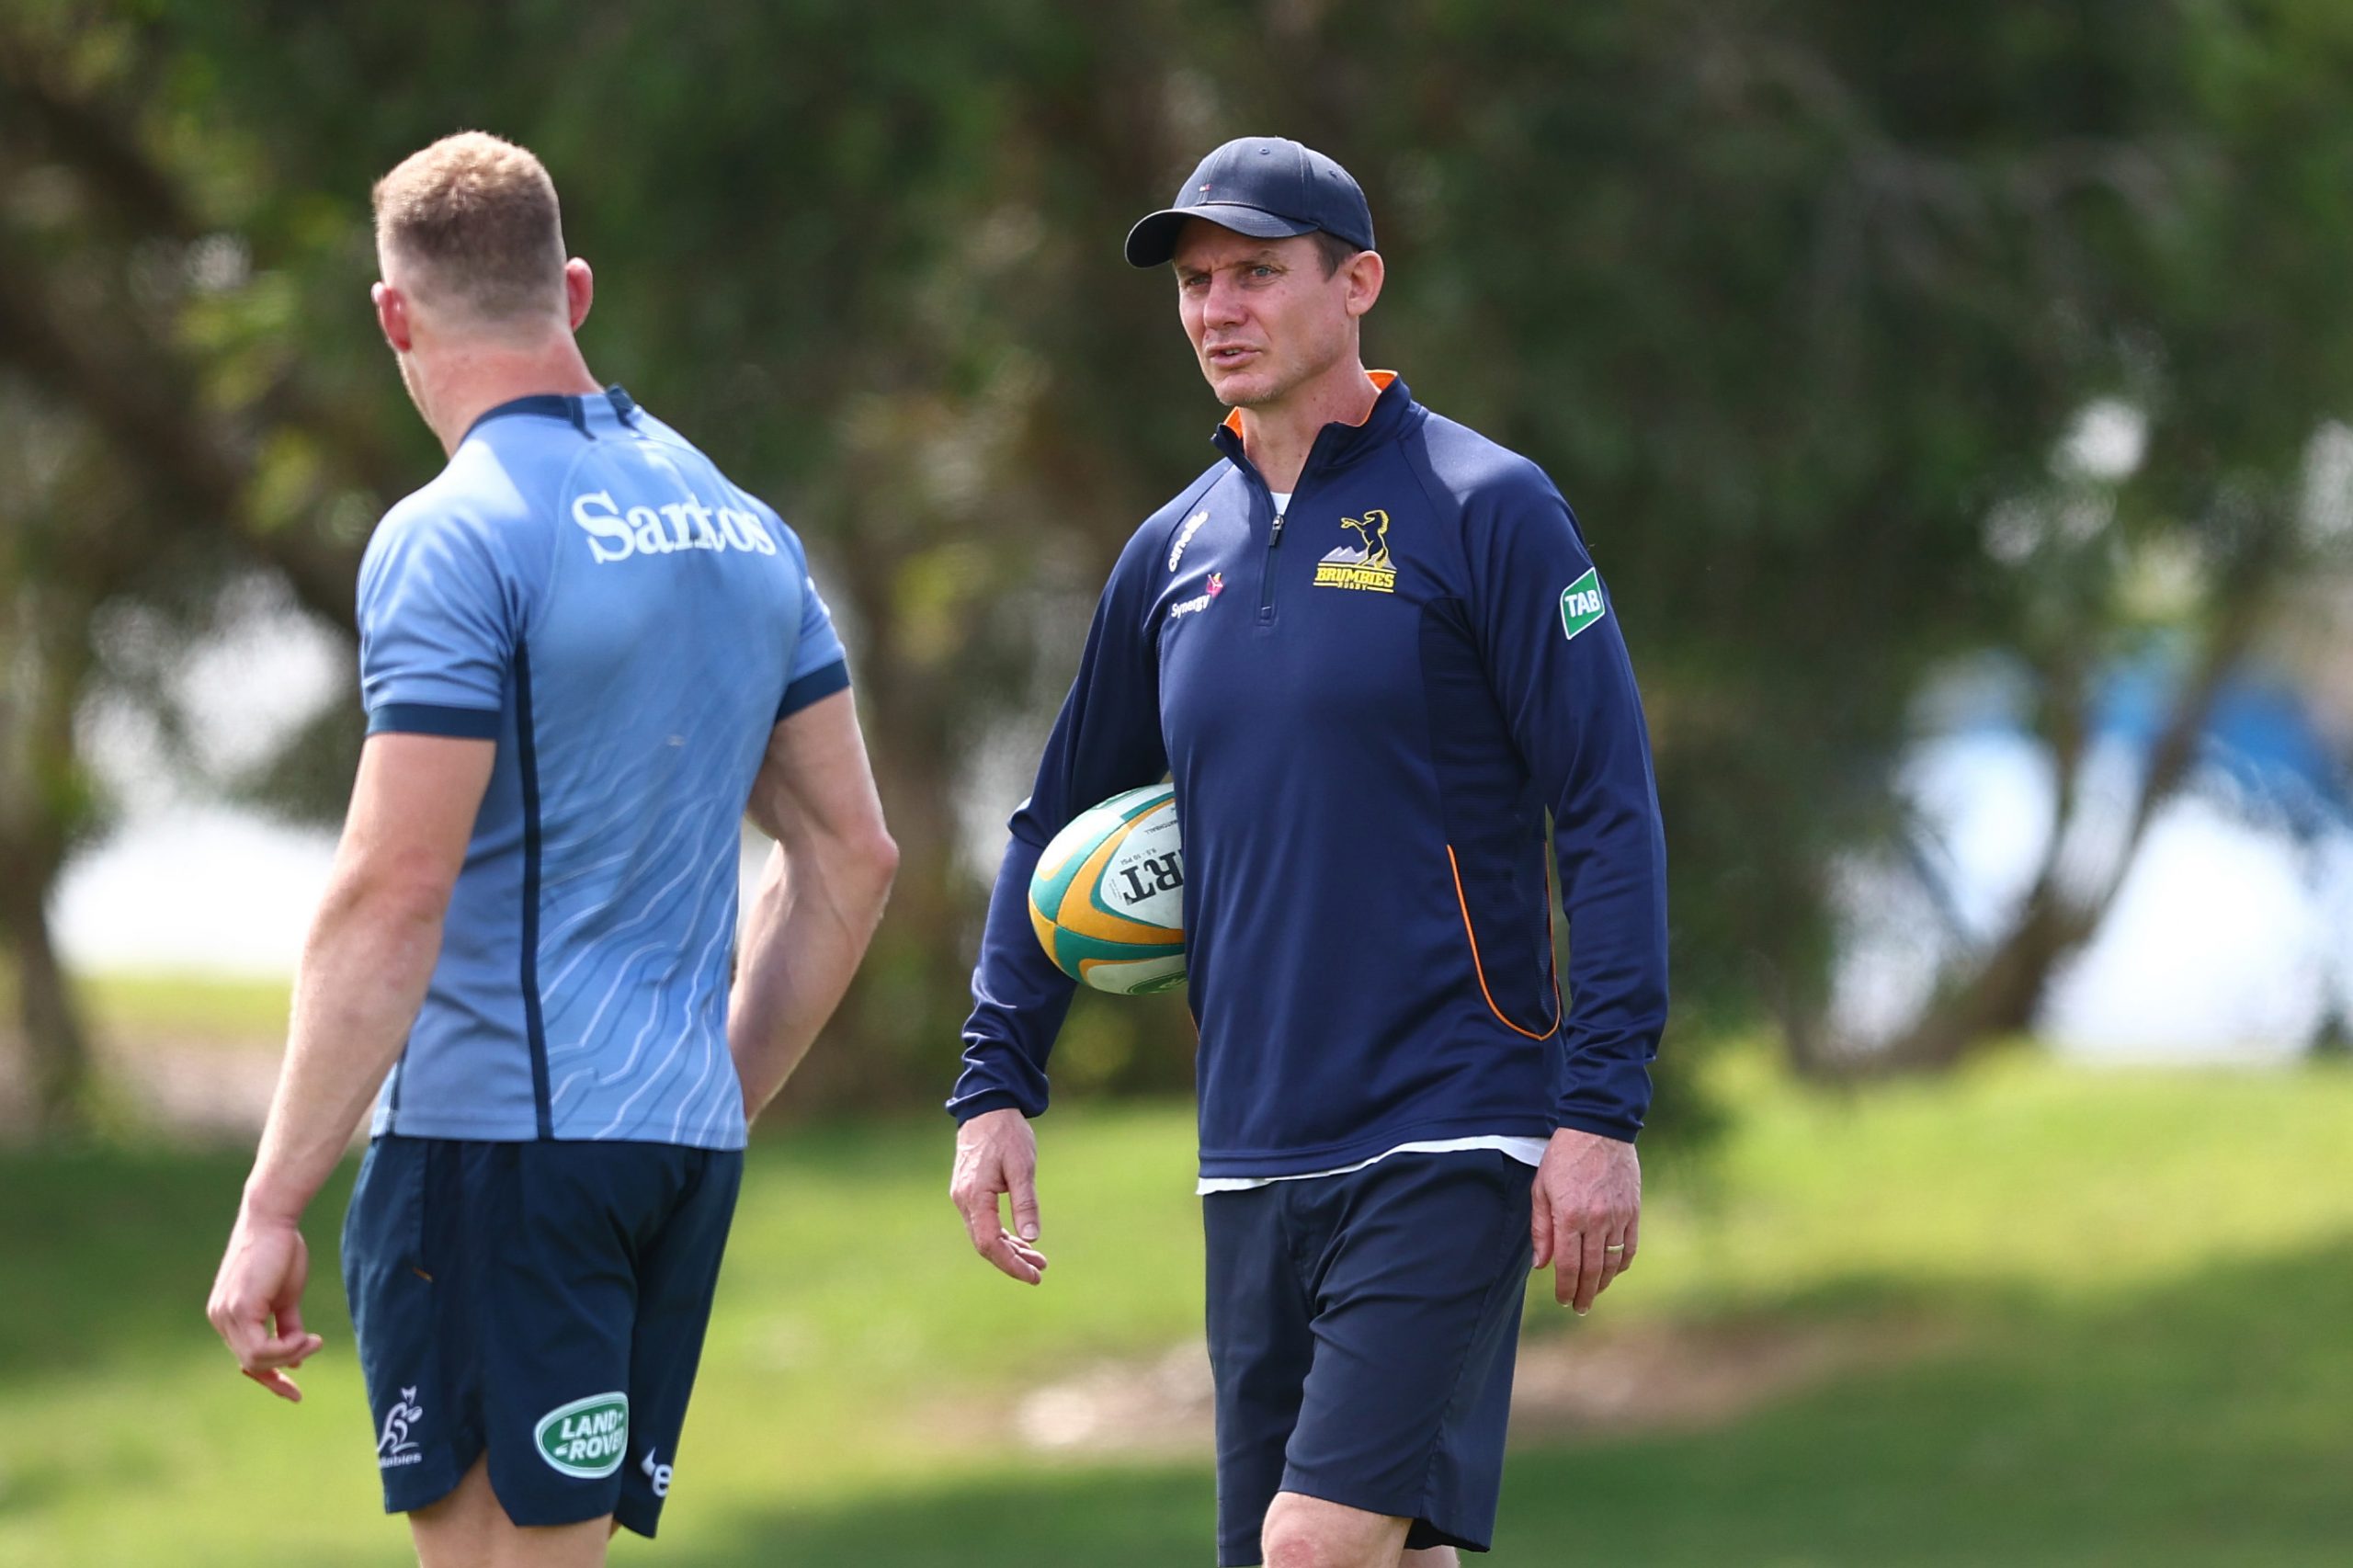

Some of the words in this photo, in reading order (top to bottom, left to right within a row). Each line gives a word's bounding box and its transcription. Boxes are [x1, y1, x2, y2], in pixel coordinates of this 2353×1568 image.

[571, 490, 776, 564] Santos
[1314, 567, 1395, 587] BRUMBIES
[1171, 595, 1211, 619] Synergy
[1564, 589, 1600, 618] TAB
[1120, 849, 1184, 906] RT
